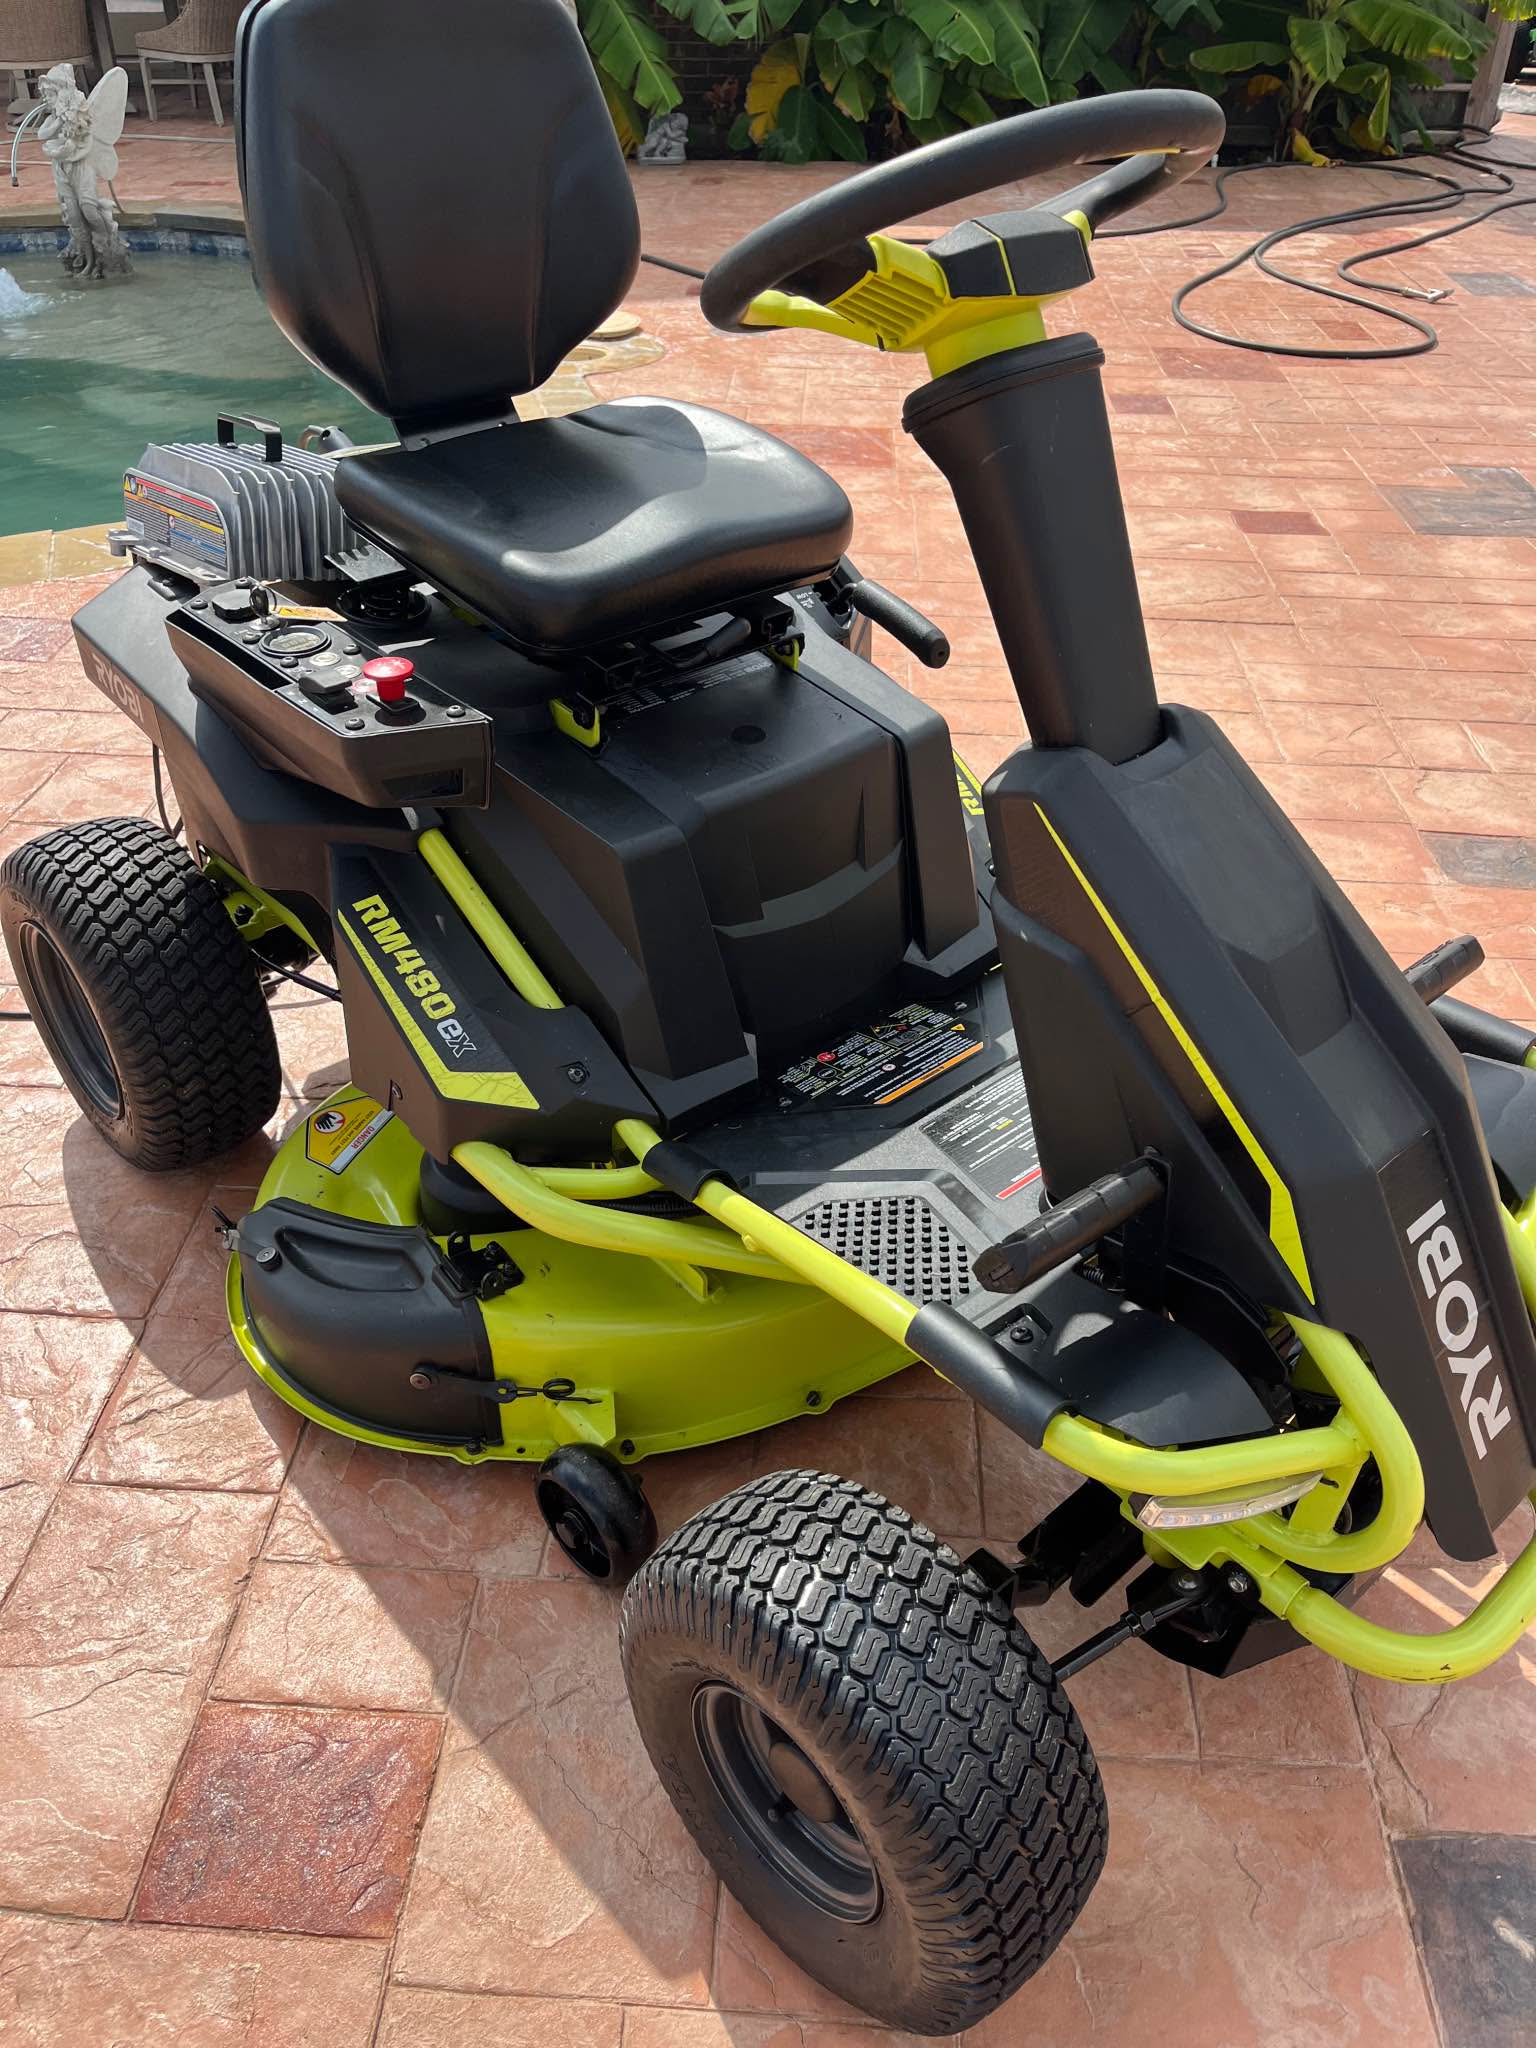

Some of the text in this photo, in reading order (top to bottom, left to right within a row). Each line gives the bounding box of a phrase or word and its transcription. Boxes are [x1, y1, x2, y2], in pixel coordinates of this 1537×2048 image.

[92, 653, 144, 723] RYOBI
[350, 1125, 376, 1149] DANGER
[1406, 1199, 1512, 1460] RYOBI
